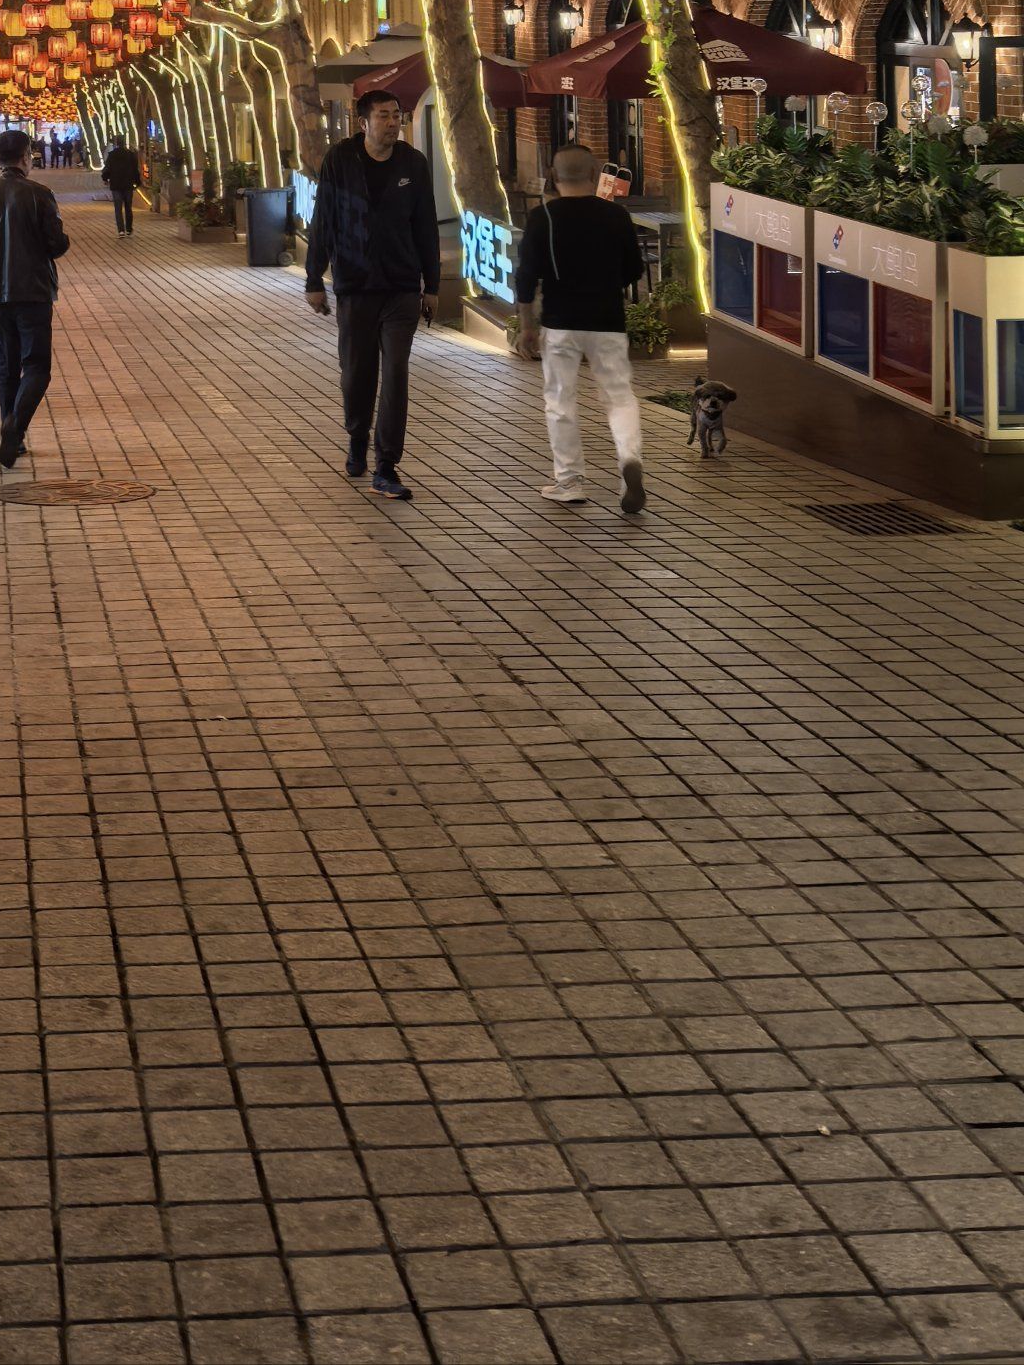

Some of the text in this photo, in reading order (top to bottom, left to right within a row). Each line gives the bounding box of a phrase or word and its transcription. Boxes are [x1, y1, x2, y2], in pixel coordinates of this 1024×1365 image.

[716, 76, 755, 91] 汉堡王
[461, 211, 514, 304] 汉堡王
